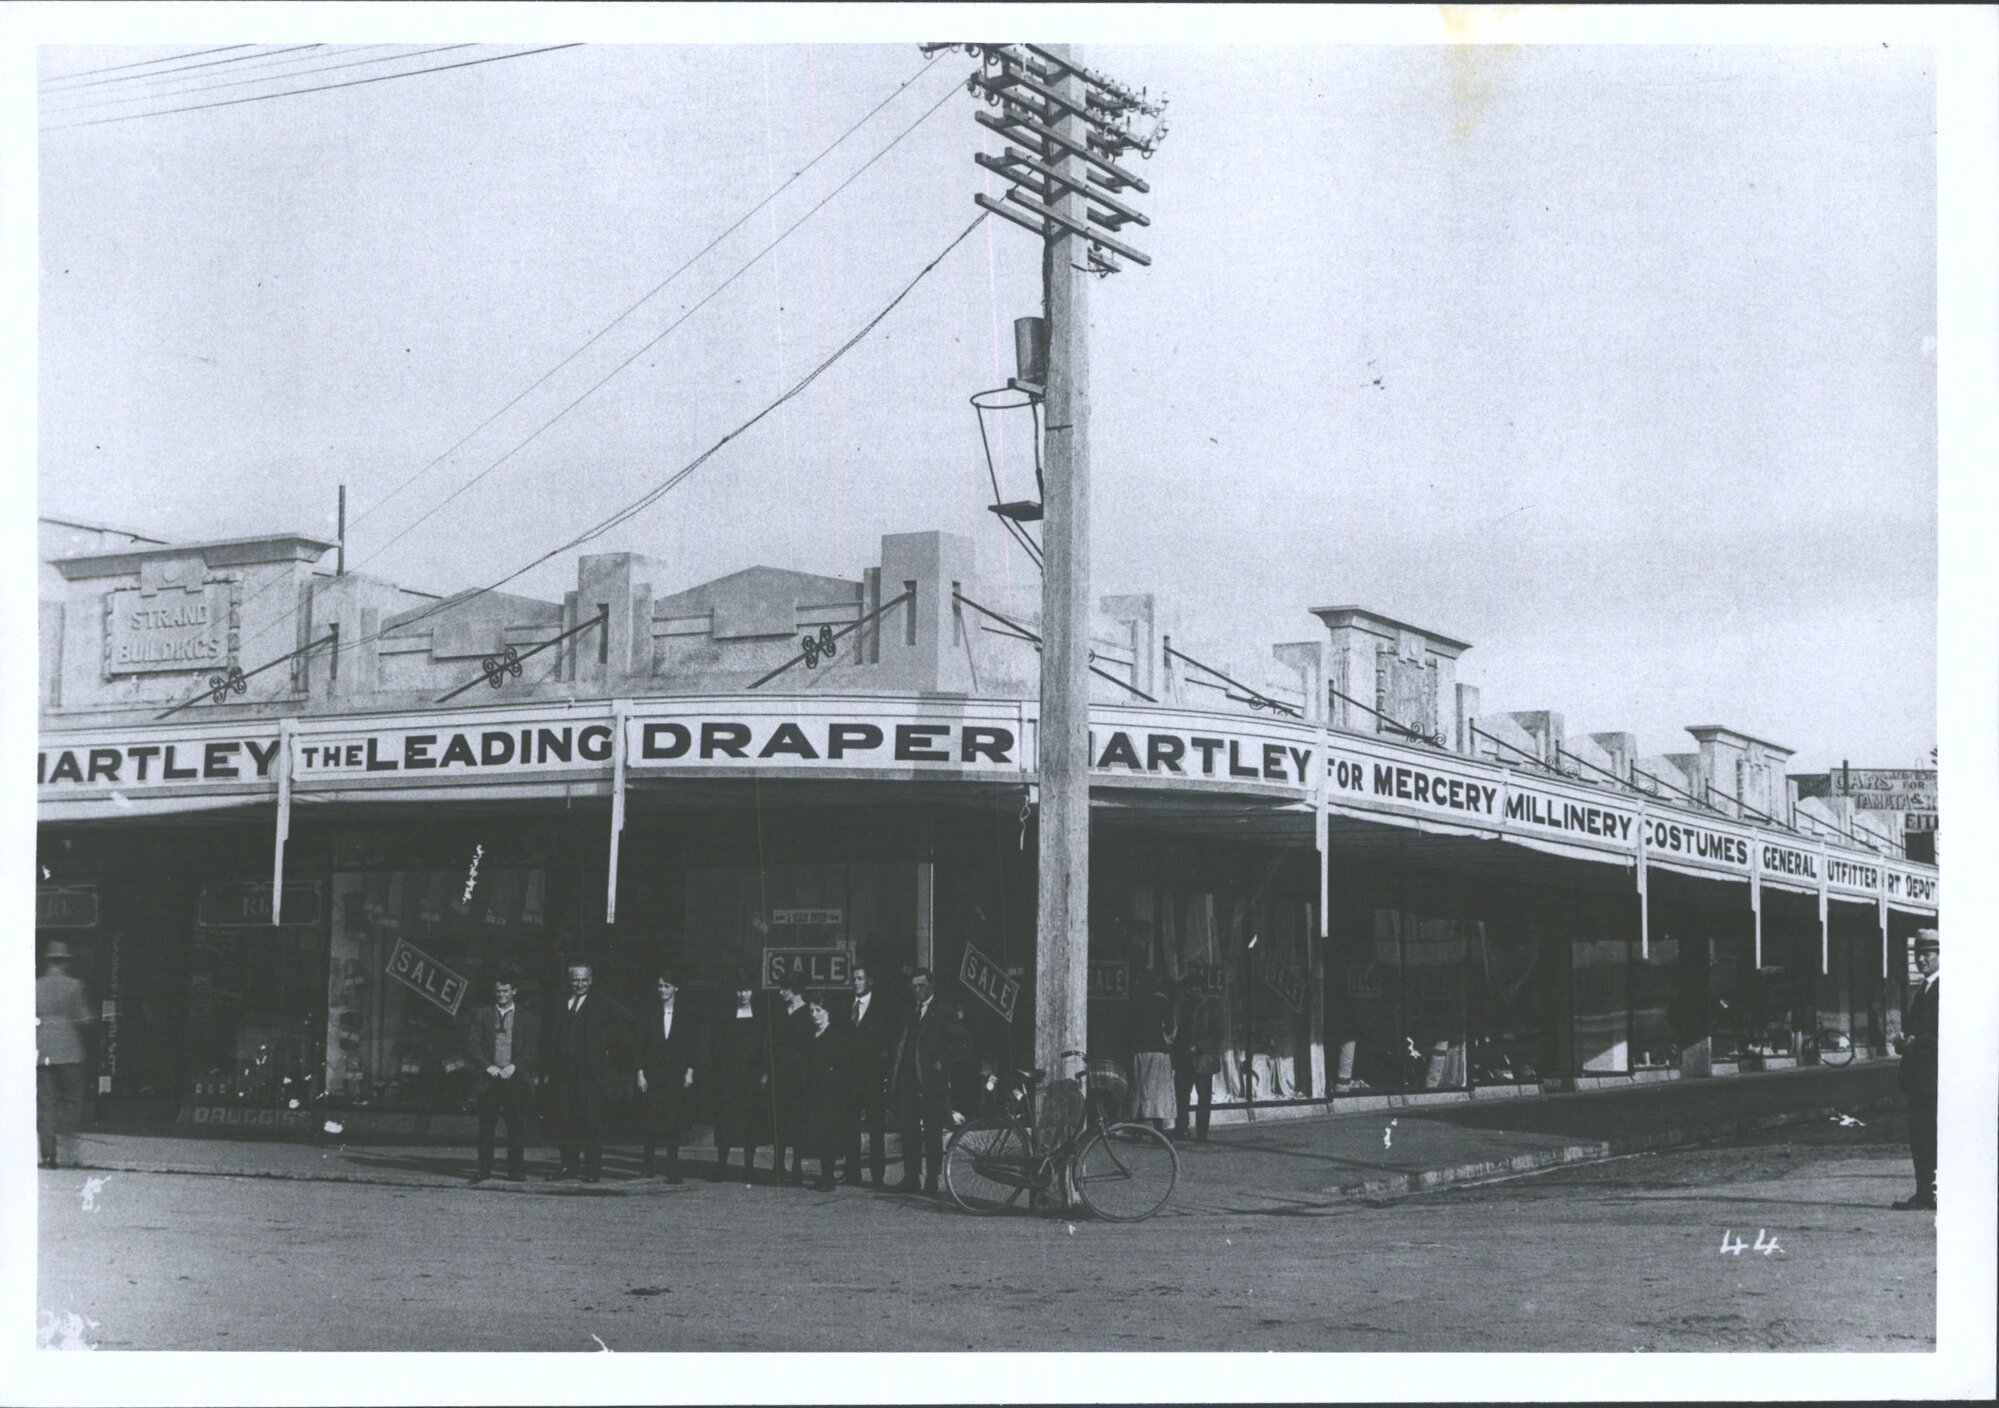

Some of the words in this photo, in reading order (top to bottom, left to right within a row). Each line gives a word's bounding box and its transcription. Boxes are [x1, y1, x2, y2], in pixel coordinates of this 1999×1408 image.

[132, 606, 209, 630] STRAND
[117, 637, 220, 664] BUILDINGS
[302, 746, 363, 768] THE
[366, 726, 613, 771] LEADING
[642, 722, 1015, 763] DRAPER
[1374, 764, 1497, 814] MERCERY
[1506, 793, 1632, 841] MILLINERY
[1645, 819, 1748, 865] COSTUMES
[1763, 846, 1817, 879] GENERAL
[1827, 860, 1877, 889] UTFITTER
[398, 951, 457, 1003] SALE
[771, 955, 846, 981] SALE
[967, 955, 1012, 1007] SALE
